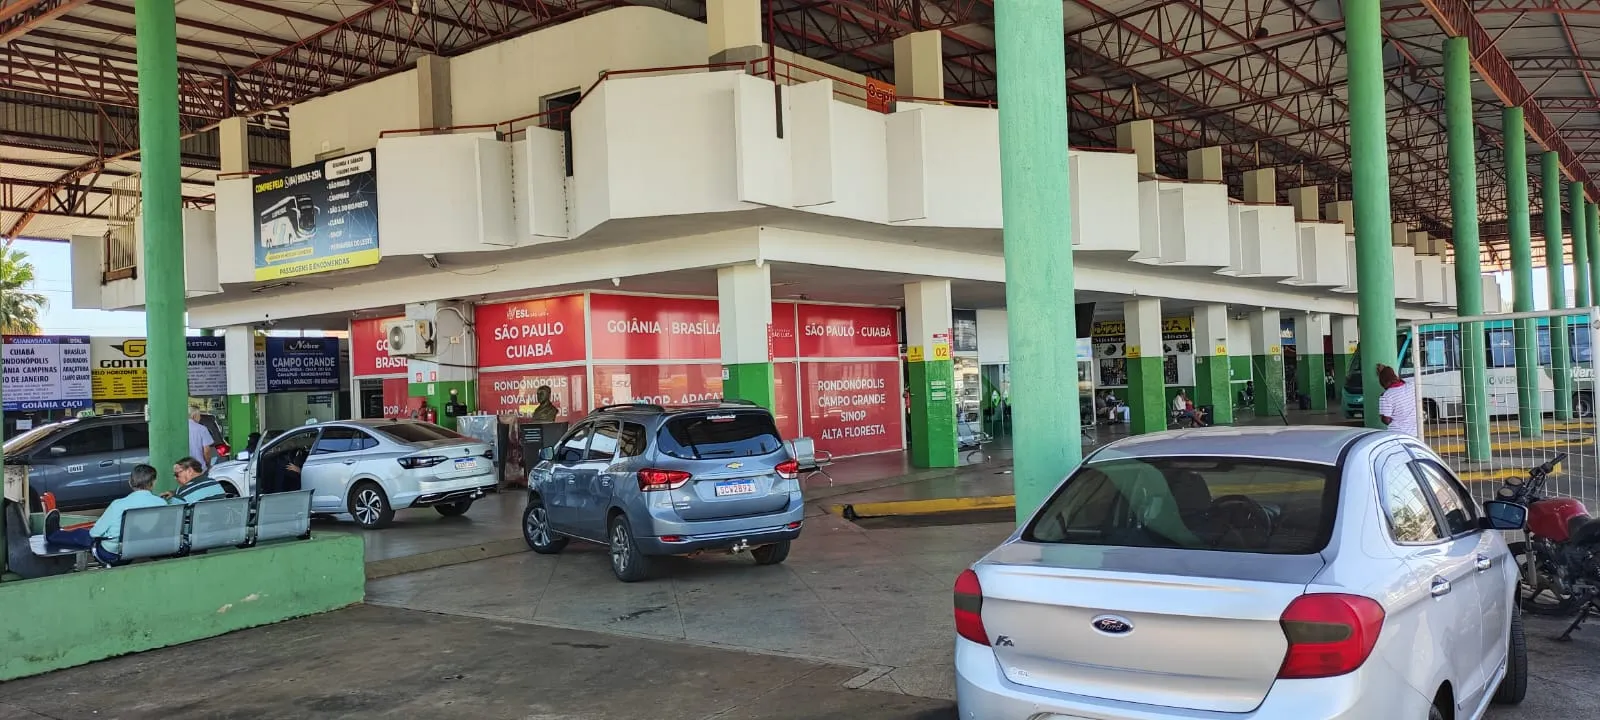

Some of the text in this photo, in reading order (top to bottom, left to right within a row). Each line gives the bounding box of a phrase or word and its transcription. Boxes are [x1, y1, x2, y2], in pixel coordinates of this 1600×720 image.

[272, 179, 284, 190] PELO
[280, 264, 309, 275] PASSAGENS
[312, 257, 350, 270] ENCOMENDAS
[515, 309, 530, 318] ESL
[494, 321, 564, 340] SÃO PAULO
[607, 317, 662, 334] GOIÂNIA
[671, 319, 720, 335] BRASÍLIA
[805, 322, 824, 336] SÃO
[826, 325, 855, 337] PAULO
[861, 325, 892, 337] CUIABÁ
[506, 340, 553, 358] CUIABÁ
[935, 347, 947, 357] 02
[272, 357, 302, 368] CAMPO
[303, 356, 336, 367] GRANDE
[23, 366, 58, 374] CAMPINAS
[21, 375, 49, 383] JANEIRO
[494, 377, 567, 391] RONDONÓPOLIS
[817, 376, 885, 391] RONDONÓPOLIS
[22, 401, 58, 409] GOIÂNIA
[61, 400, 83, 408] CAÇU
[500, 395, 526, 405] NOVA
[818, 393, 886, 407] CAMPO GRANDE
[840, 410, 866, 422] SINOP
[821, 424, 886, 440] ALTA FLORESTA
[1101, 620, 1122, 632] Ford
